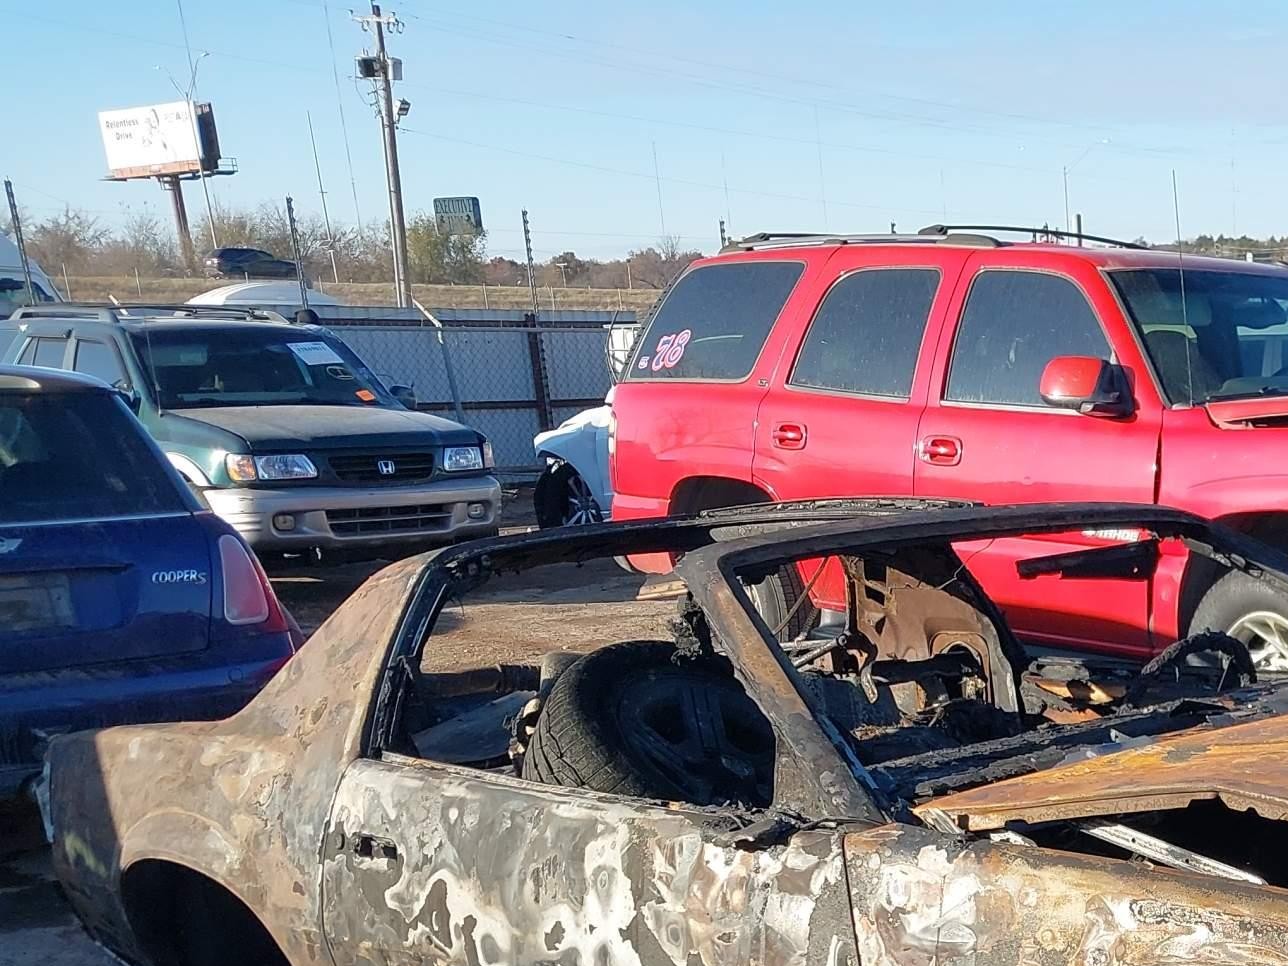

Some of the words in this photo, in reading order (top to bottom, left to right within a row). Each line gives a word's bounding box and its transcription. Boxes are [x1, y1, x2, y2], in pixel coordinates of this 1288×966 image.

[435, 199, 473, 213] EXECUTIVE
[652, 329, 692, 371] 78
[151, 569, 198, 584] COOPER
